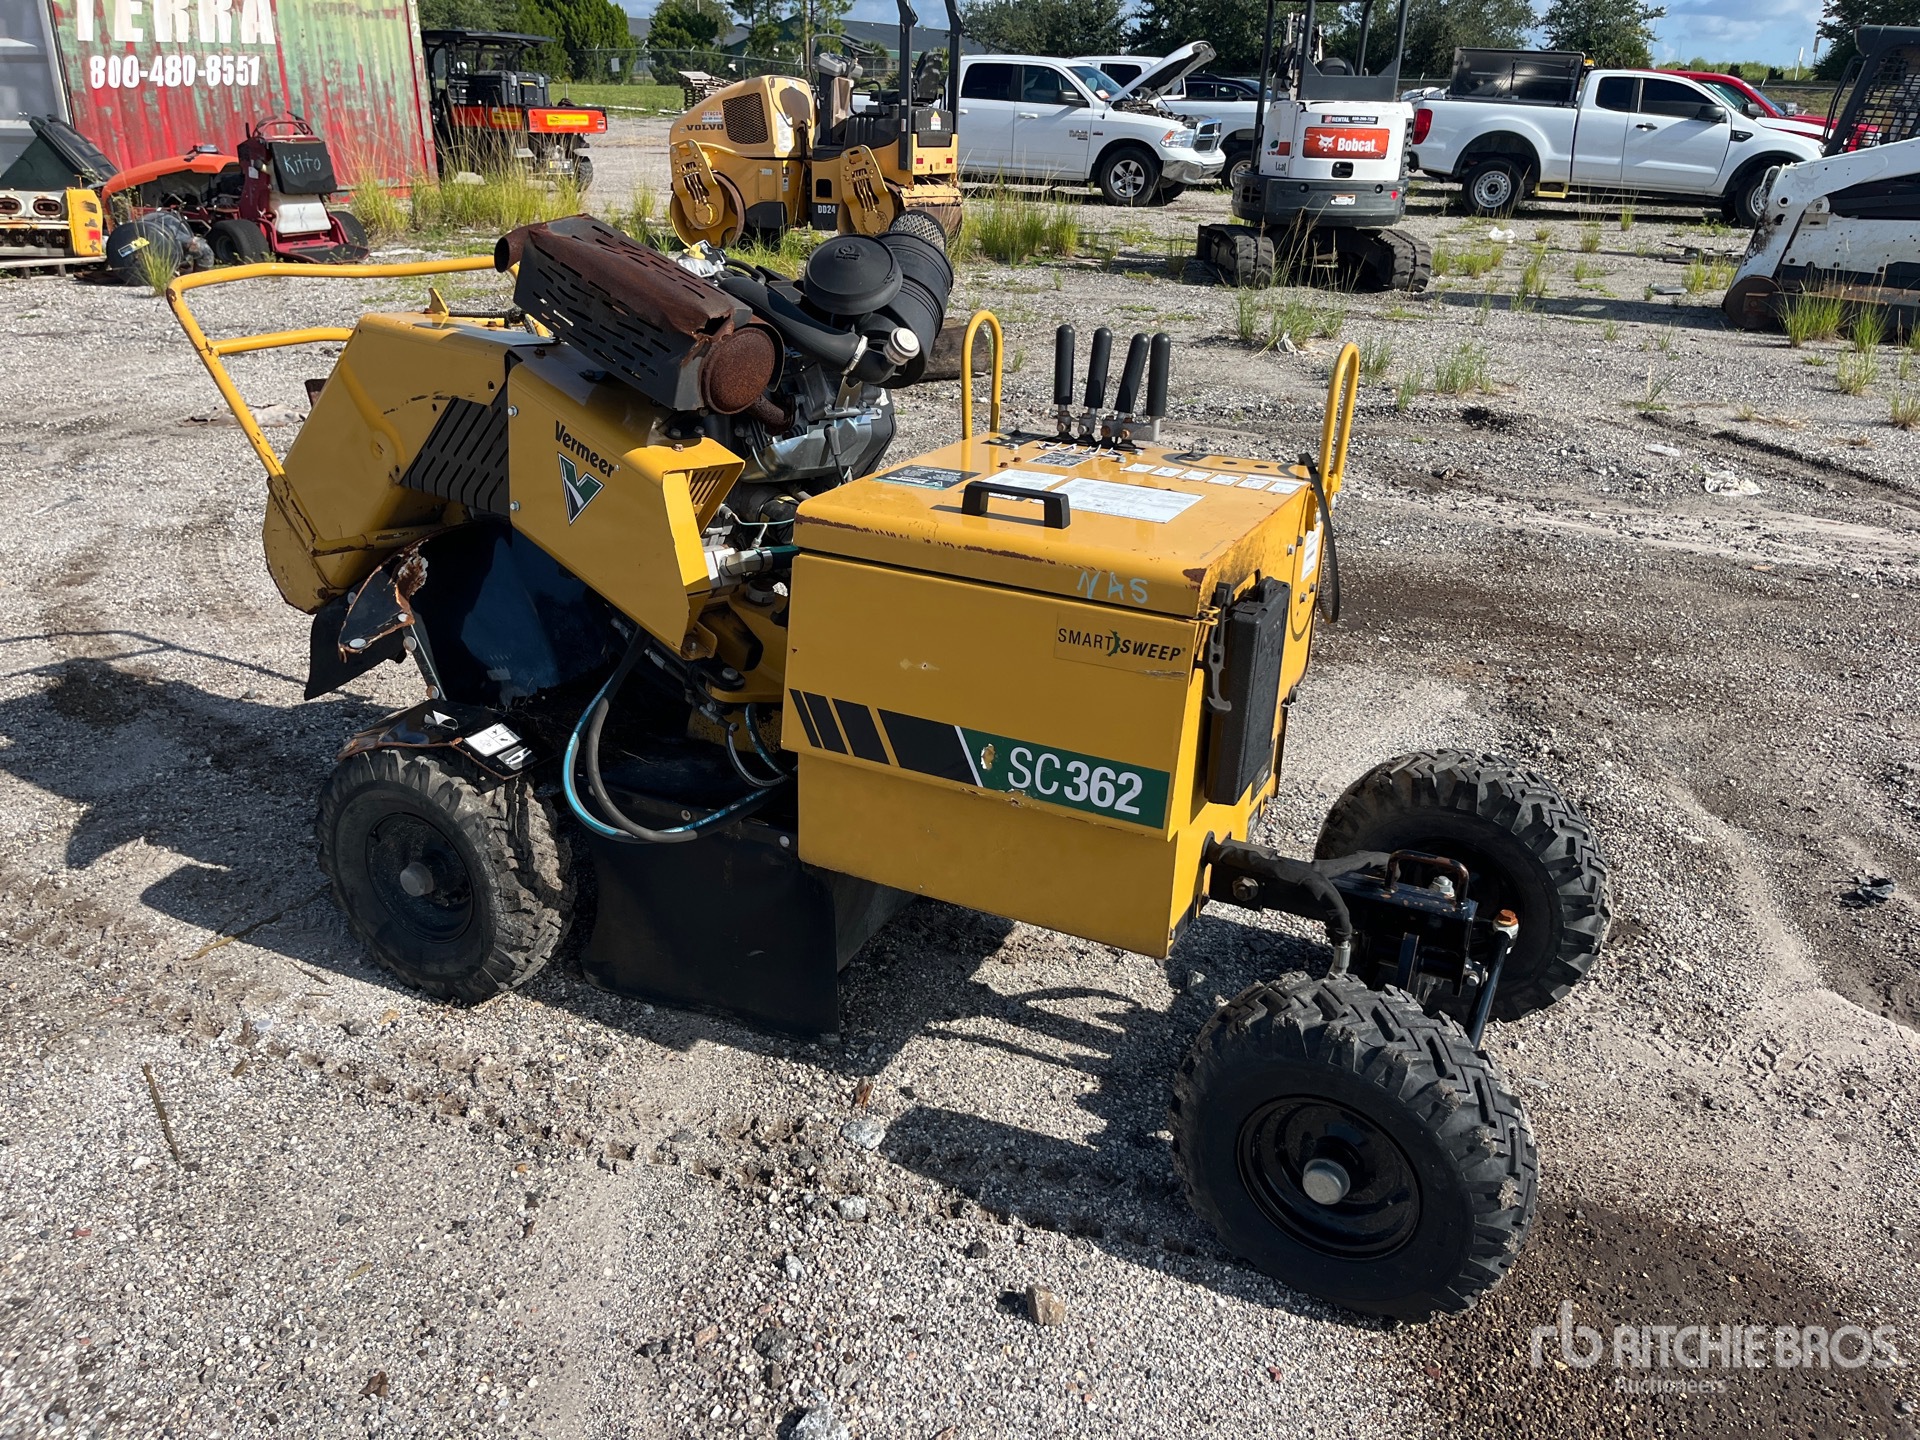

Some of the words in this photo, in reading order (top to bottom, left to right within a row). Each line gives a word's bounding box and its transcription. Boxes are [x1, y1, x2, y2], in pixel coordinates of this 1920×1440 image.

[90, 54, 261, 89] 800-480-8551
[1337, 138, 1376, 152] Bobcat
[817, 205, 836, 214] DD24
[555, 420, 615, 478] Vermeer
[1077, 570, 1148, 604] NAS
[1058, 628, 1113, 651] SMART
[1007, 747, 1143, 815] SC362
